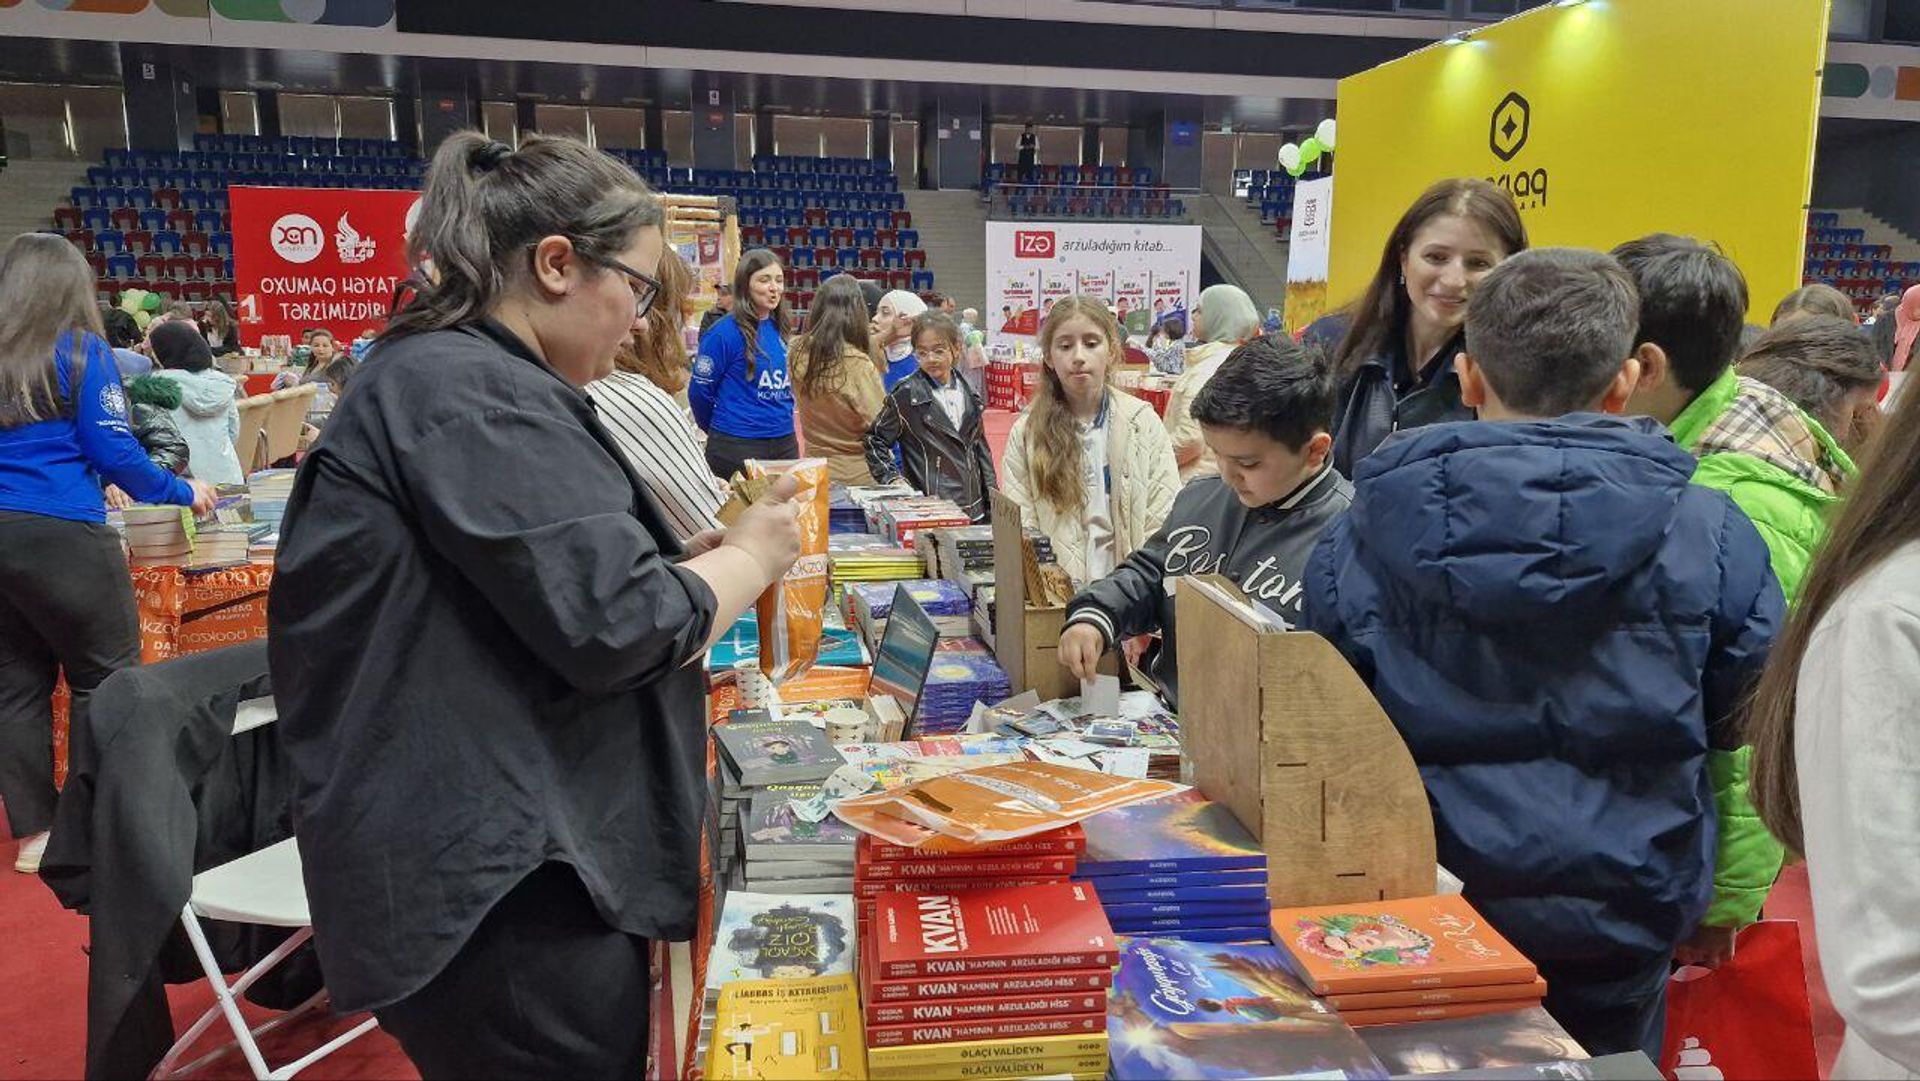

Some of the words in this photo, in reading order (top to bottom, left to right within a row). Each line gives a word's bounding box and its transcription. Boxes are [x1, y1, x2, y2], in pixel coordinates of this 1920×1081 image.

[1062, 239, 1131, 254] arzuladığım
[260, 277, 337, 295] OXUMAQ
[343, 277, 398, 294] HƏYAT
[240, 294, 262, 323] 1
[901, 864, 936, 875] KVAN
[917, 895, 959, 953] KVAN
[926, 960, 966, 974] KVAN
[918, 982, 957, 996] KVAN
[913, 1005, 952, 1019] KVAN
[913, 1027, 952, 1041] KVAN
[961, 1049, 991, 1059] ƏLAÇI
[992, 1046, 1044, 1057] VALİDEYN
[994, 1063, 1044, 1075] VALİDEYN
